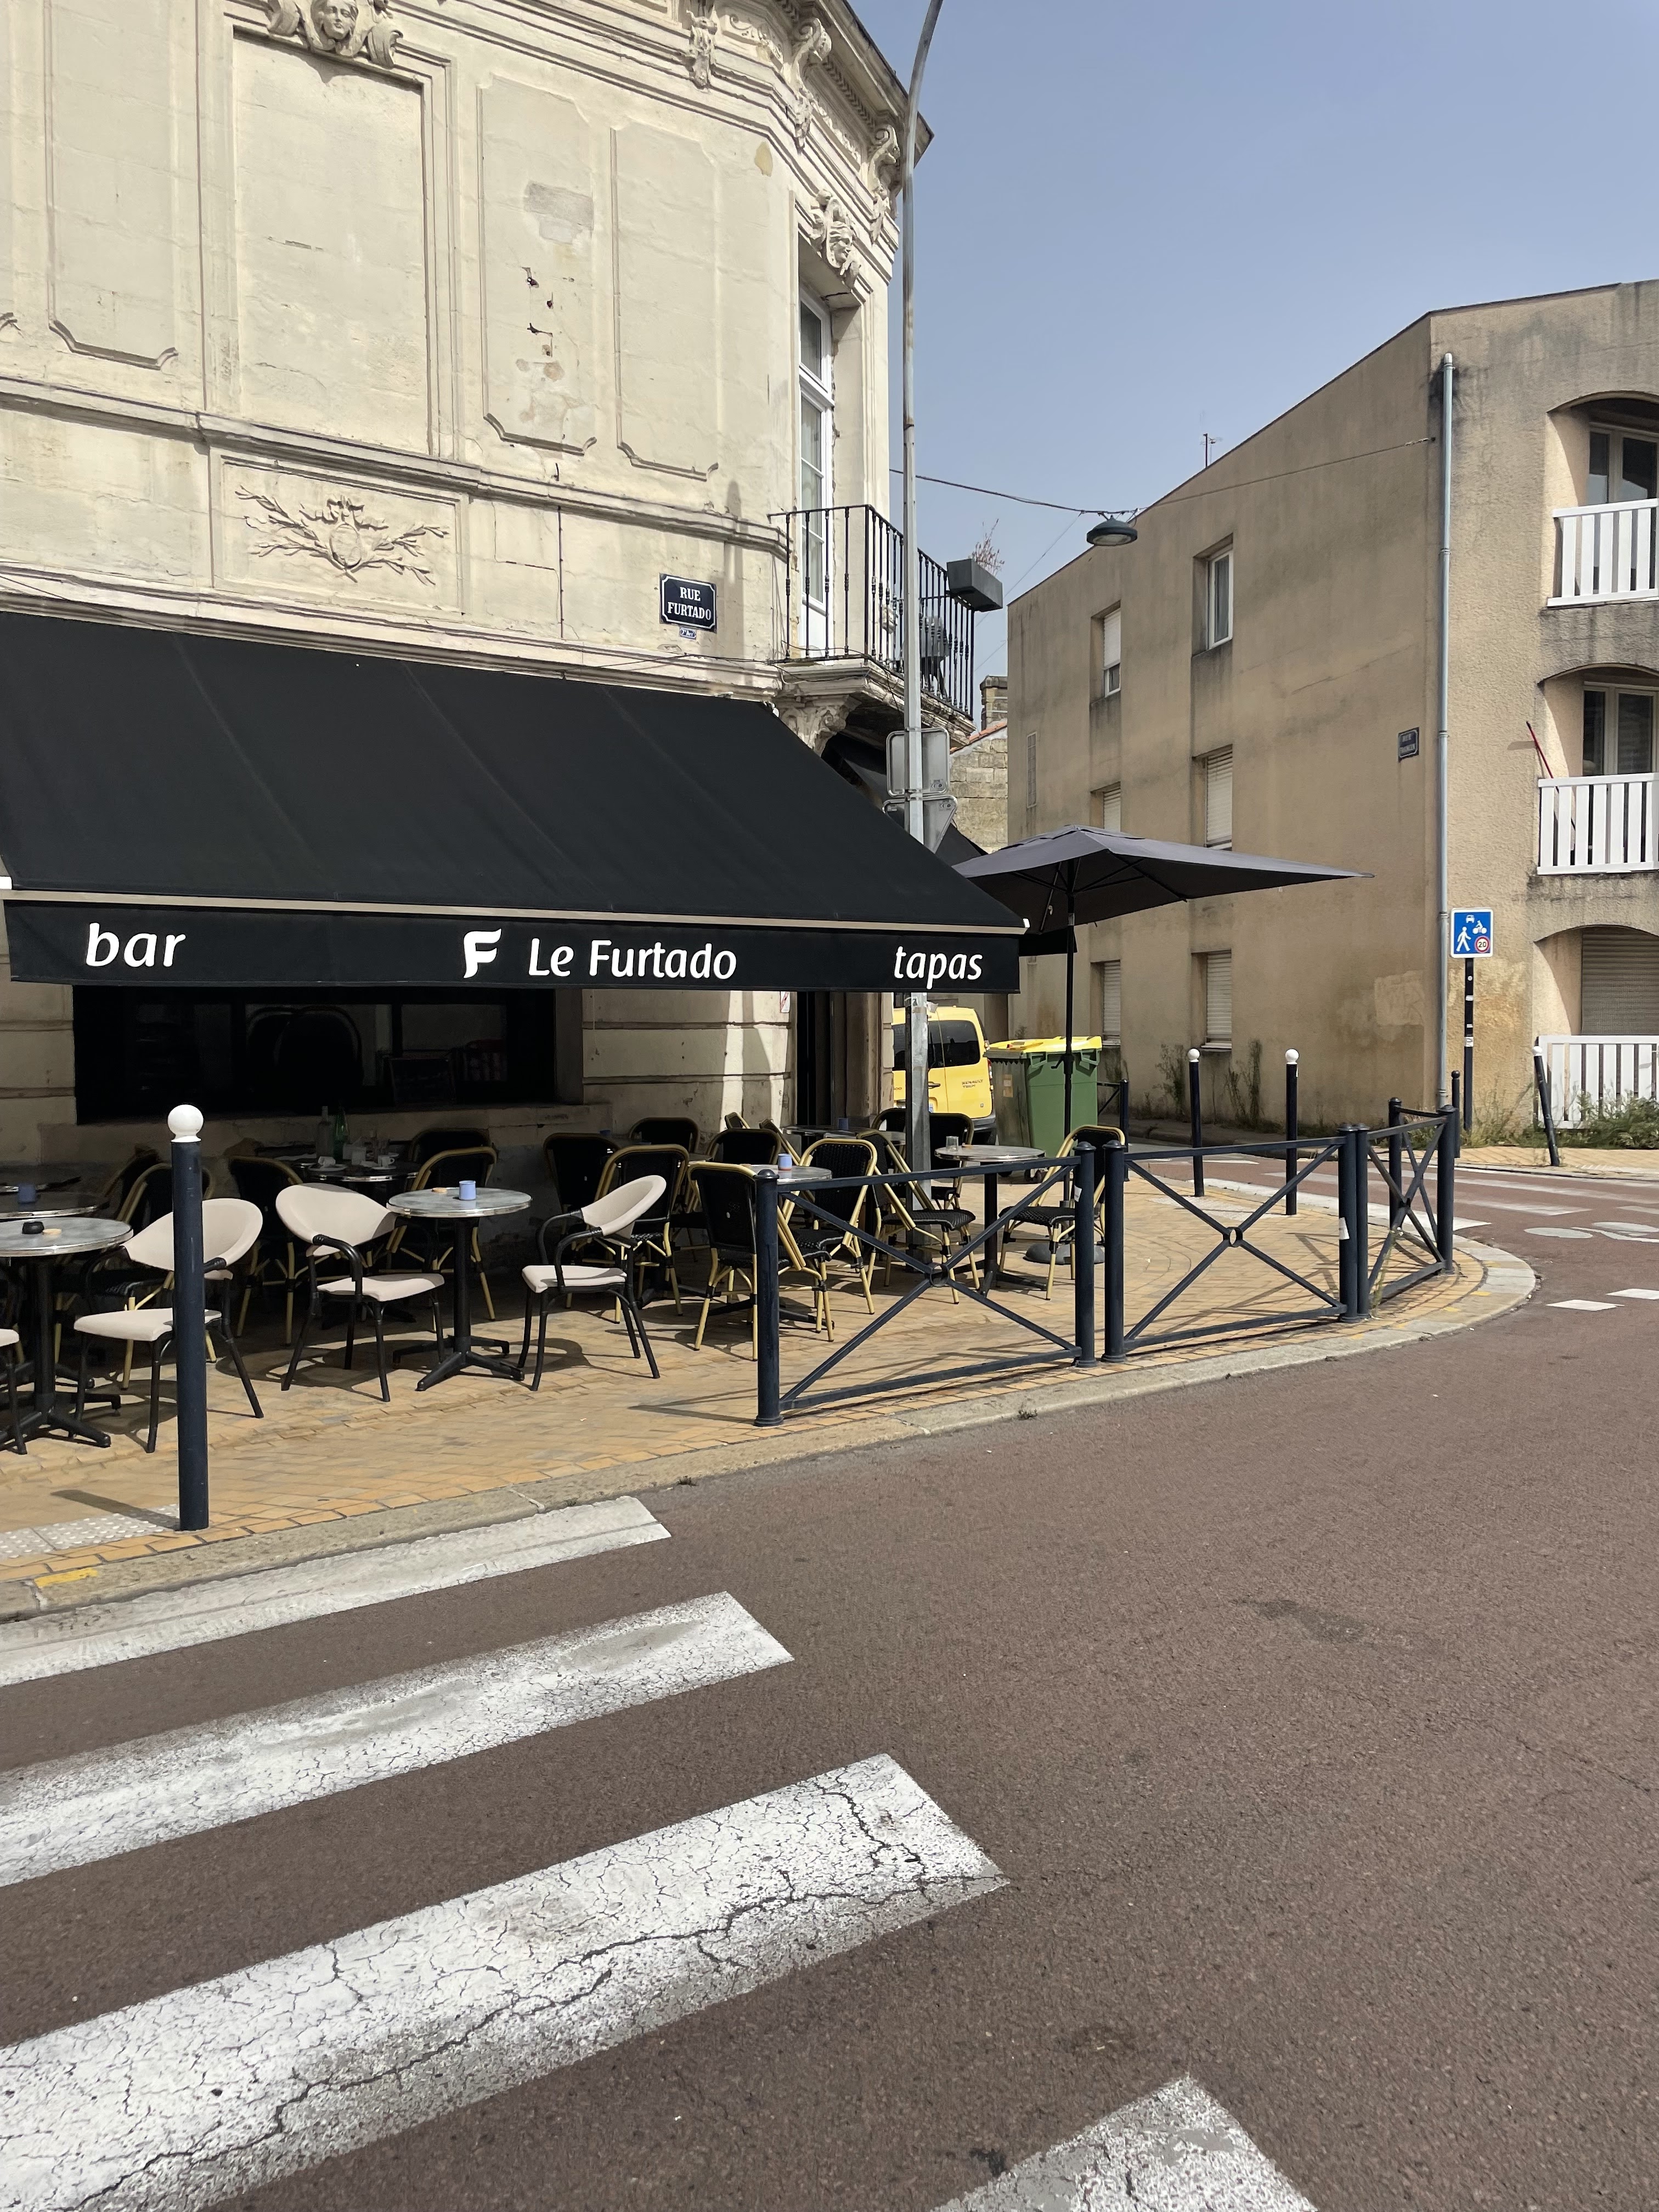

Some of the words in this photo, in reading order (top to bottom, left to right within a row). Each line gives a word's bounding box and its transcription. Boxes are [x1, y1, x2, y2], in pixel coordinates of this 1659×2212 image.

[668, 602, 712, 620] FURTADO
[680, 587, 701, 601] RUE
[86, 922, 186, 967] bar
[463, 928, 502, 979] F
[528, 938, 574, 977] Le
[589, 940, 737, 979] Furtado
[894, 946, 983, 990] tapas
